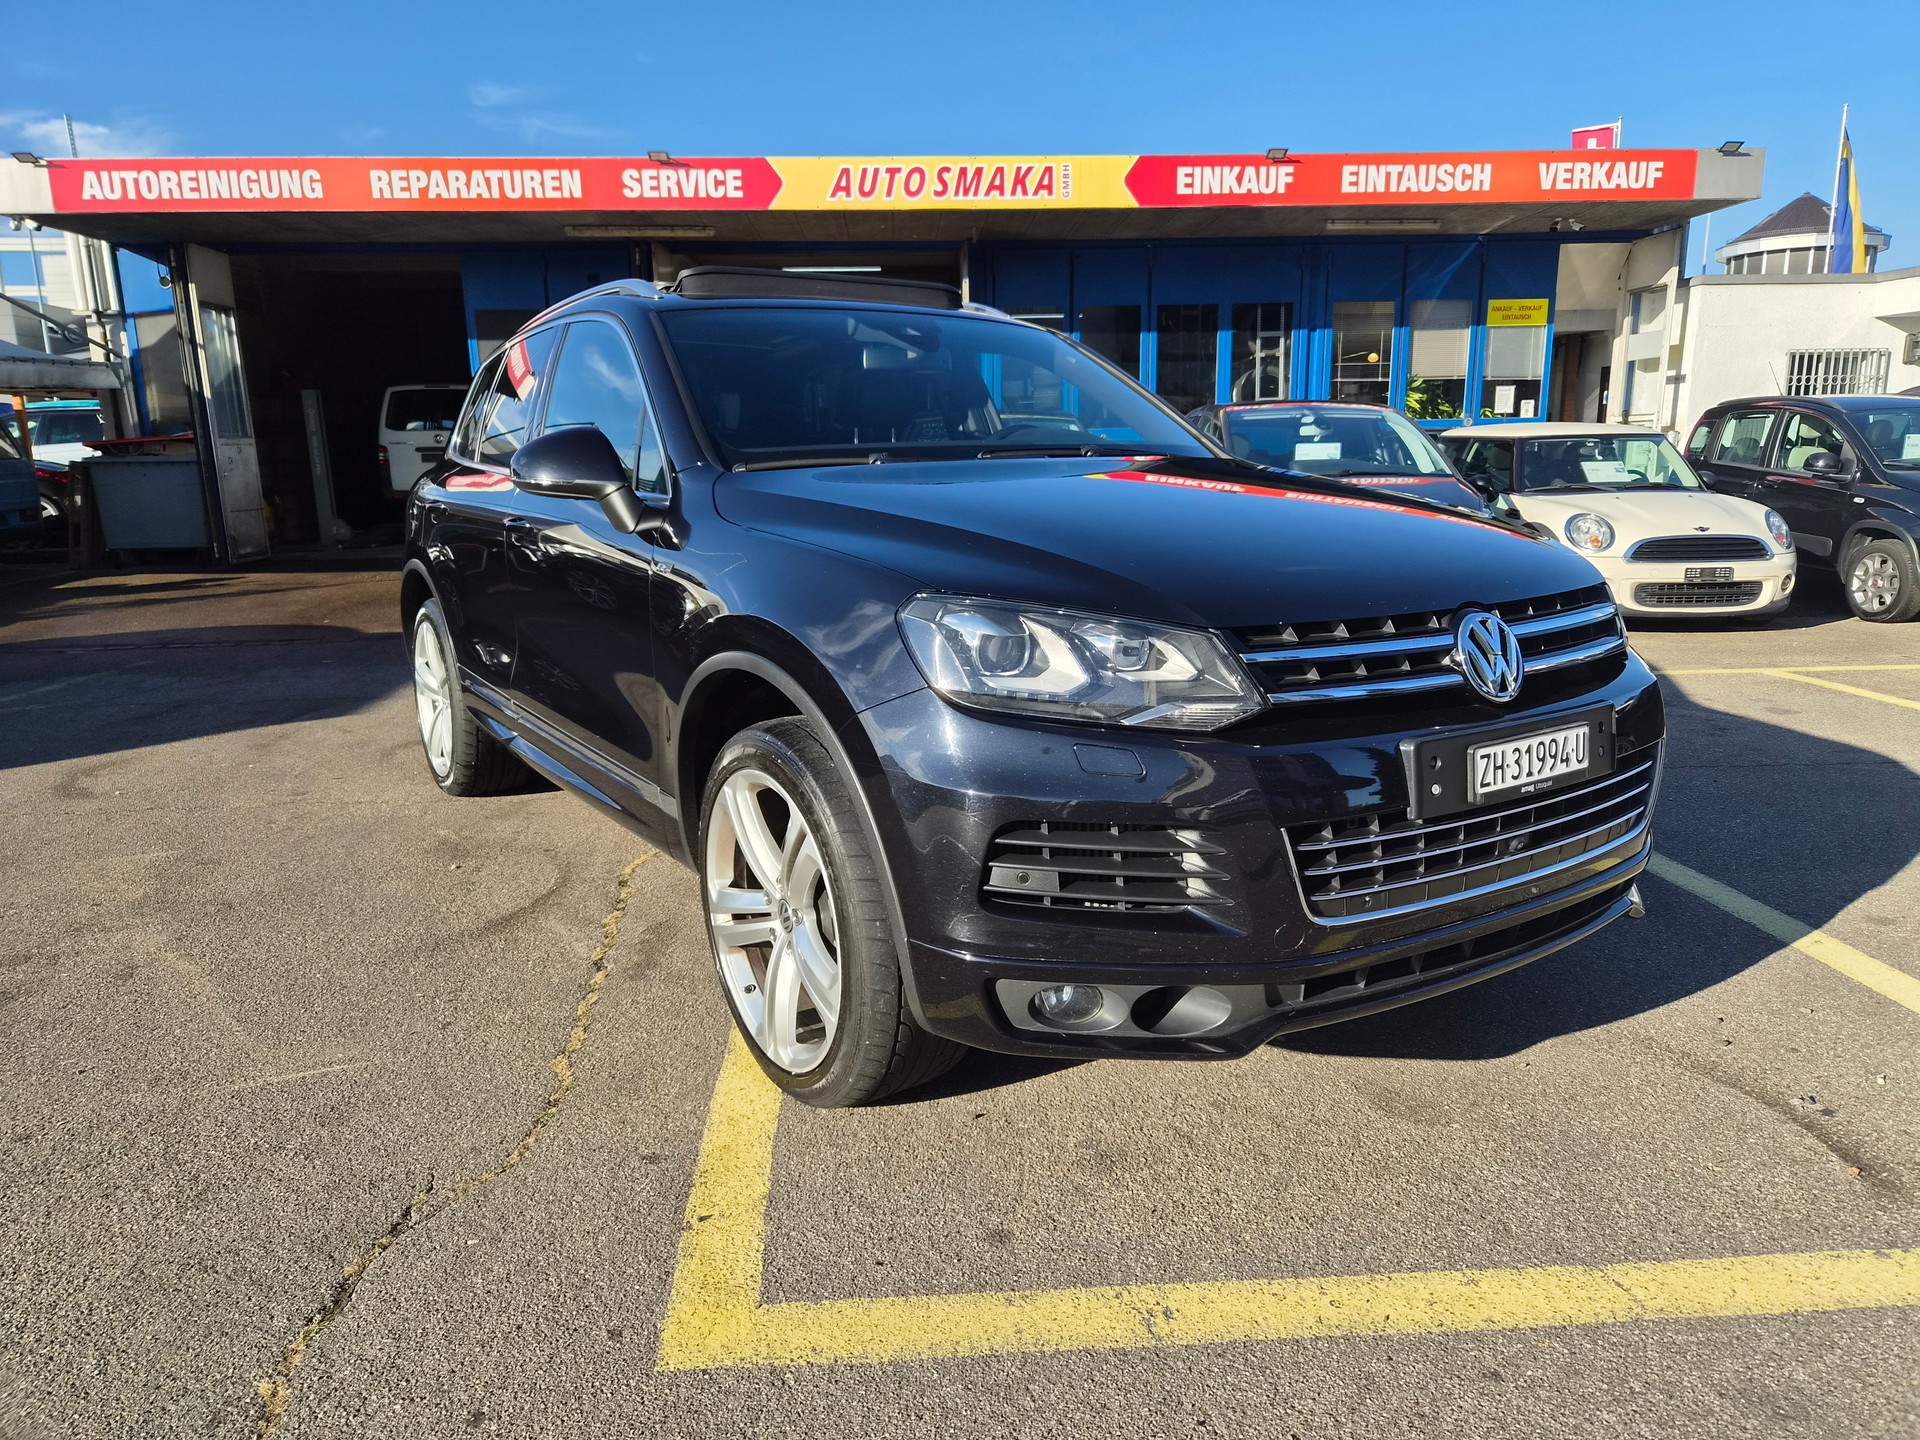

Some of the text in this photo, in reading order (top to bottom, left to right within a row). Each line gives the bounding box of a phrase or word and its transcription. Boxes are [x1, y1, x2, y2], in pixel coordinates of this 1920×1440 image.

[81, 168, 323, 201] AUTOREINIGUNG
[368, 168, 583, 200] REPARATUREN
[621, 167, 744, 199] SERVICE
[829, 165, 1054, 199] AUTO SMAKA
[1062, 164, 1070, 198] GMBH
[1176, 165, 1295, 196] EINKAUF
[1341, 162, 1492, 194] EINTAUSCH
[1538, 160, 1665, 191] VERKAUF
